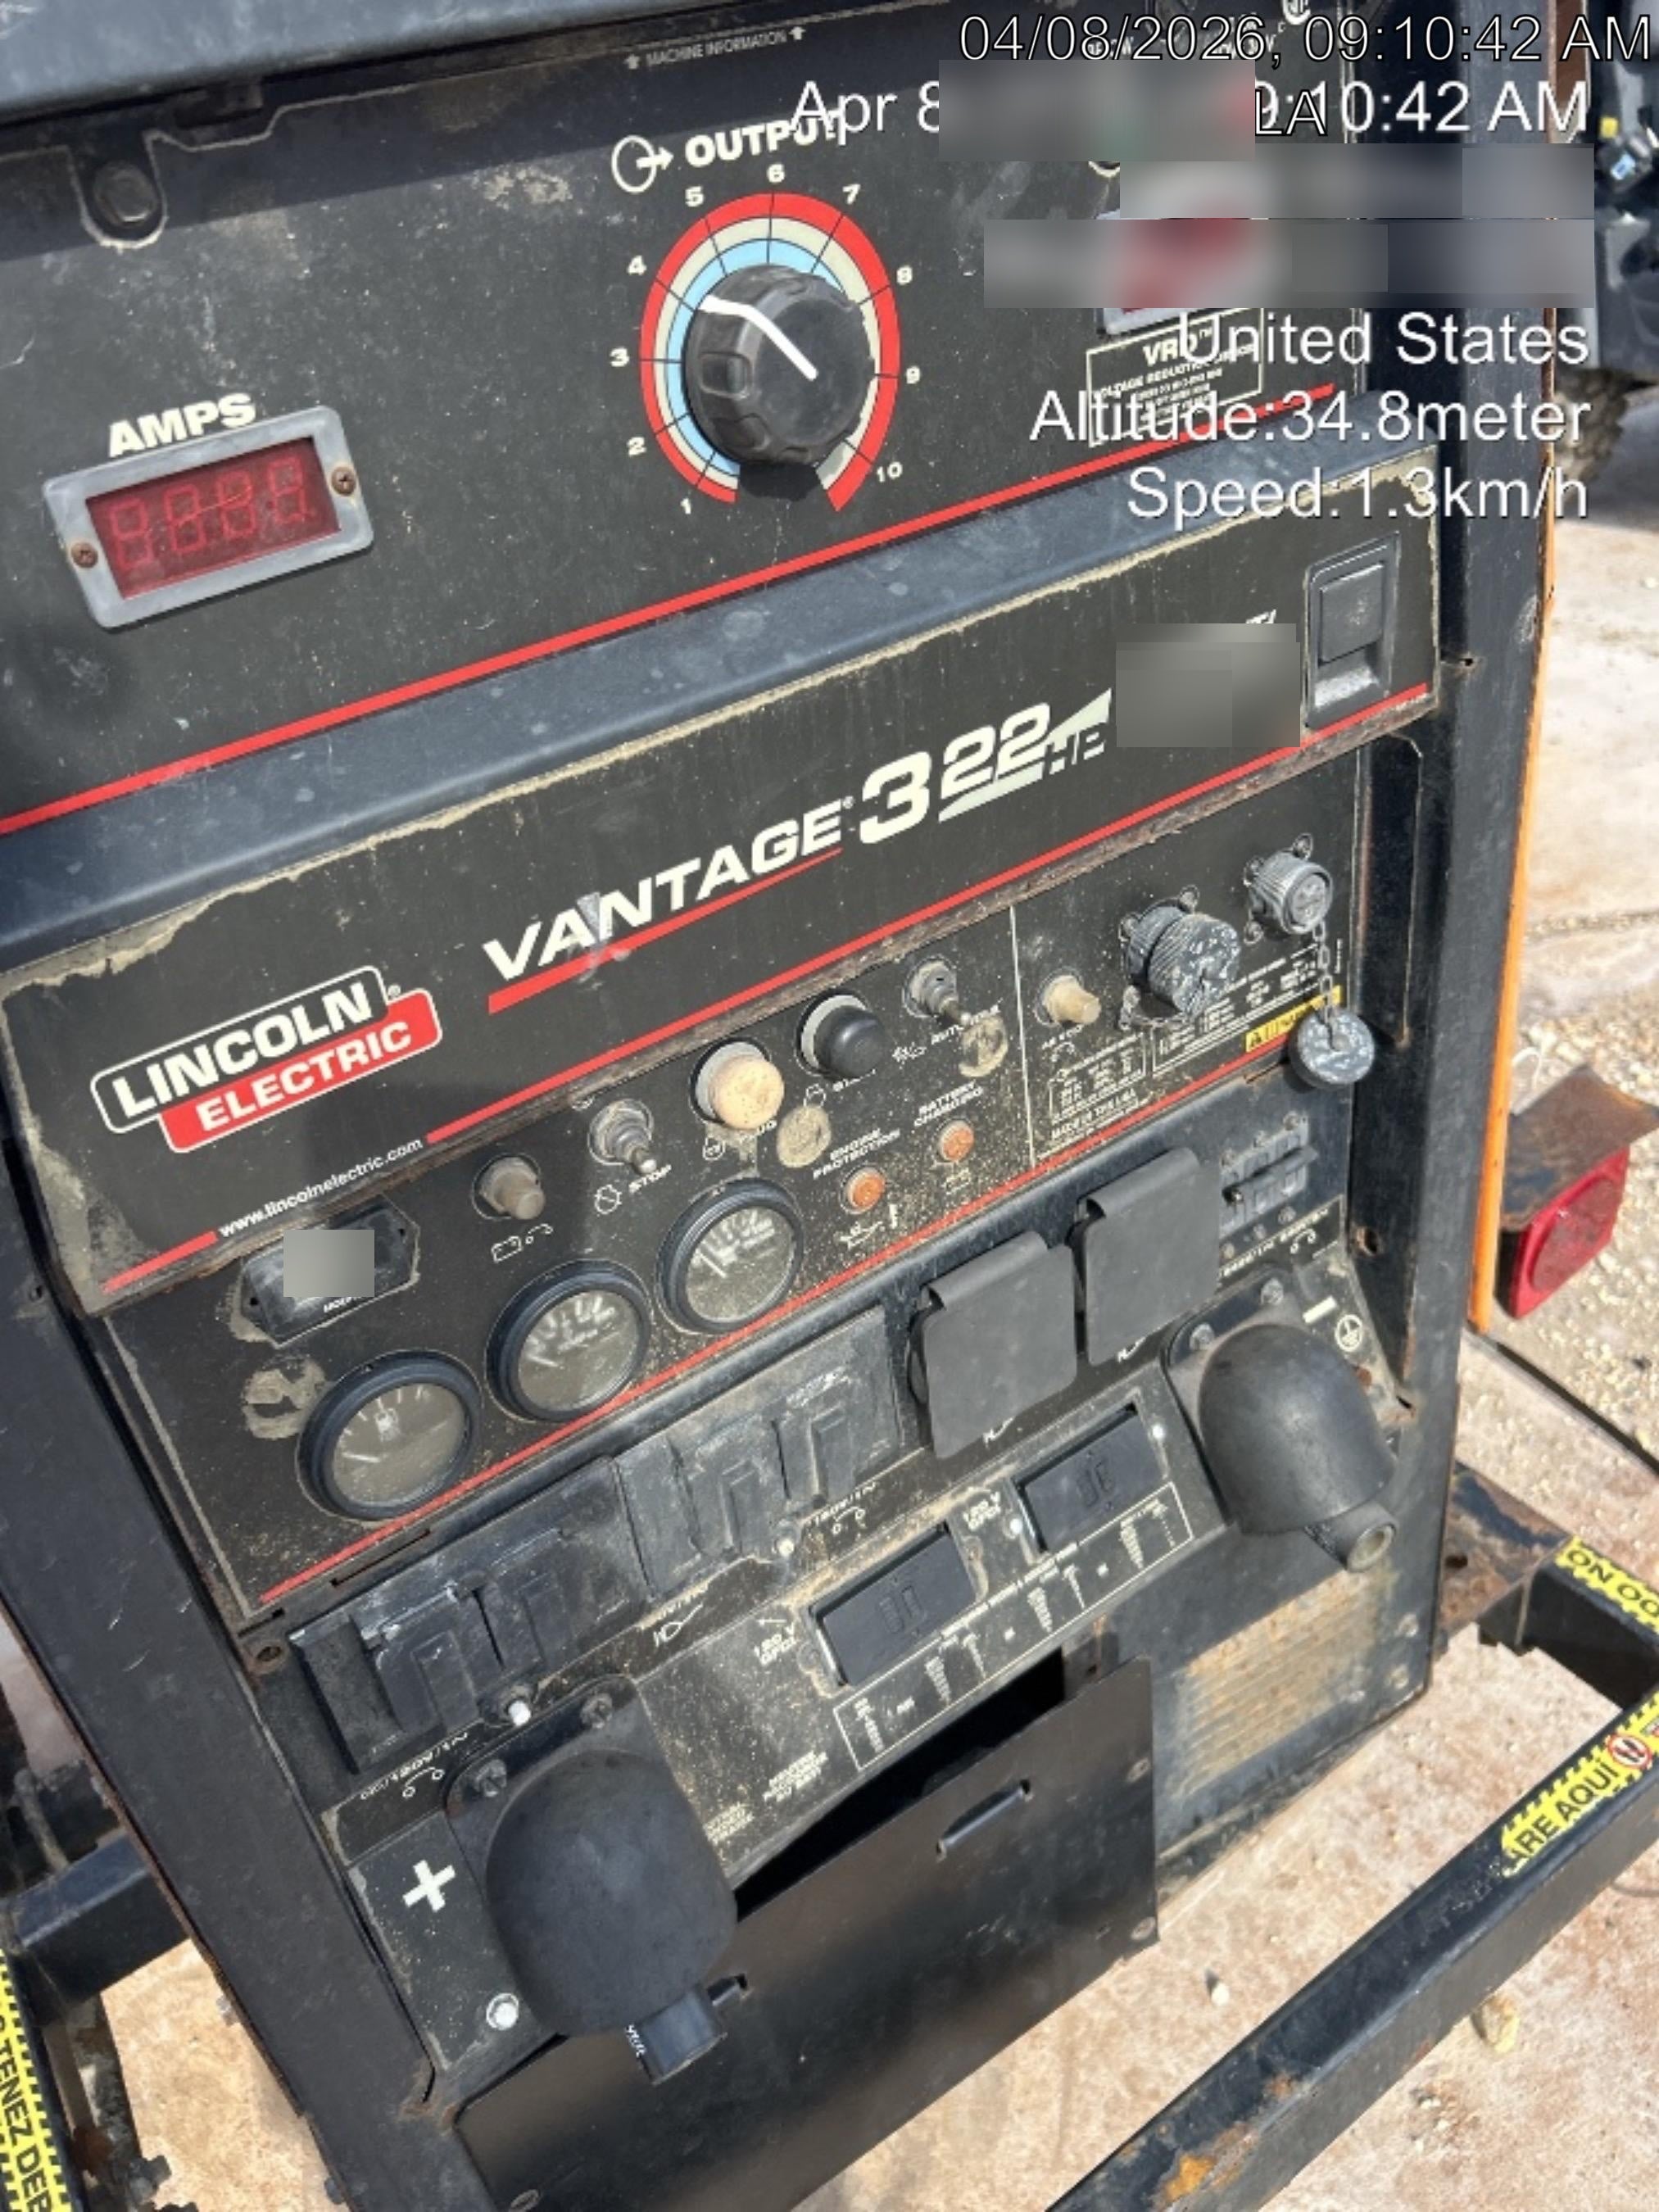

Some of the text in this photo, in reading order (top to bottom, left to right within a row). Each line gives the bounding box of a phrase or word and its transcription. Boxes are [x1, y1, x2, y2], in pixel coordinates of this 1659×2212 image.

[646, 30, 787, 66] MACHINE INFORMATION
[768, 164, 784, 182] 6
[686, 187, 704, 206] 5
[843, 184, 860, 204] 7
[628, 256, 646, 275] 4
[896, 266, 913, 284] 8
[610, 349, 628, 367] 3
[905, 367, 921, 384] 9
[109, 392, 256, 457] AMPS
[627, 437, 646, 456] 2
[877, 462, 902, 482] 10
[680, 498, 692, 514] 1
[483, 800, 843, 981] VANTAGE
[859, 703, 1051, 845] 322
[113, 982, 373, 1119] LINCOLN
[197, 1021, 412, 1132] ELECTRIC
[220, 1139, 424, 1238] www.lincolnelectric.com
